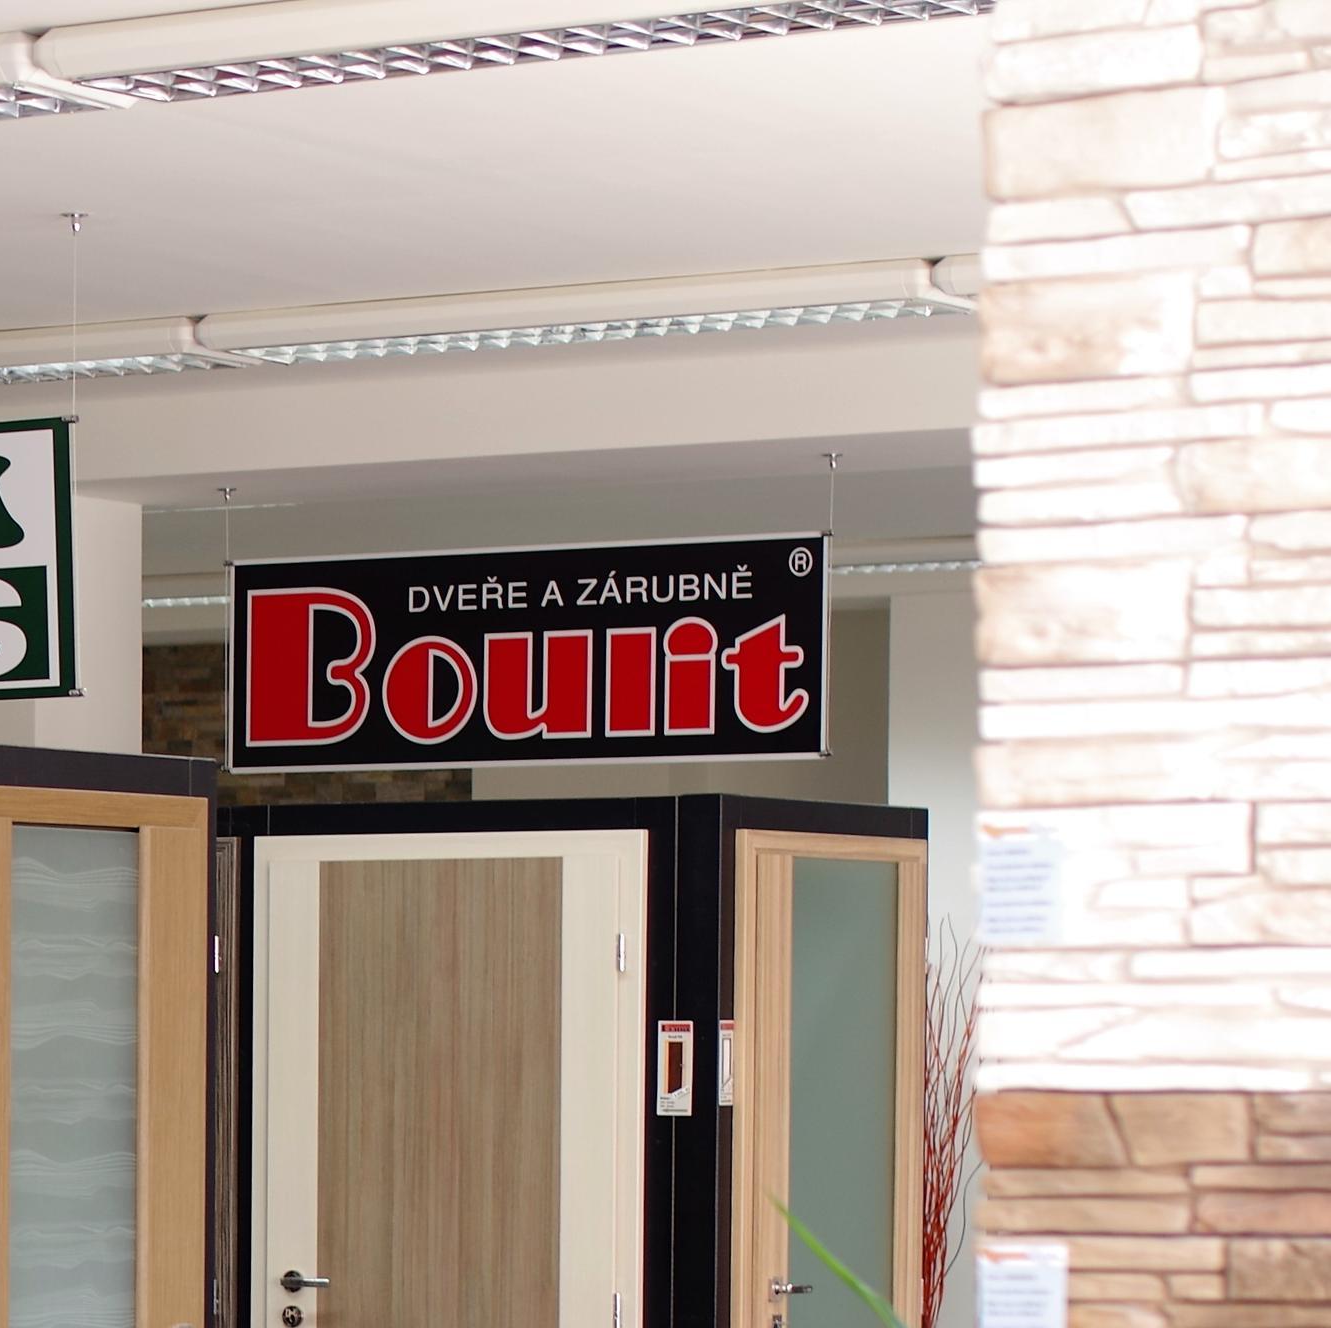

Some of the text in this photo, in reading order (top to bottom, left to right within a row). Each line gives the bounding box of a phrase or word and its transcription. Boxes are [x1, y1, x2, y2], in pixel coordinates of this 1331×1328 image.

[408, 565, 754, 613] DVEŘE A ZÁRUBNĚ
